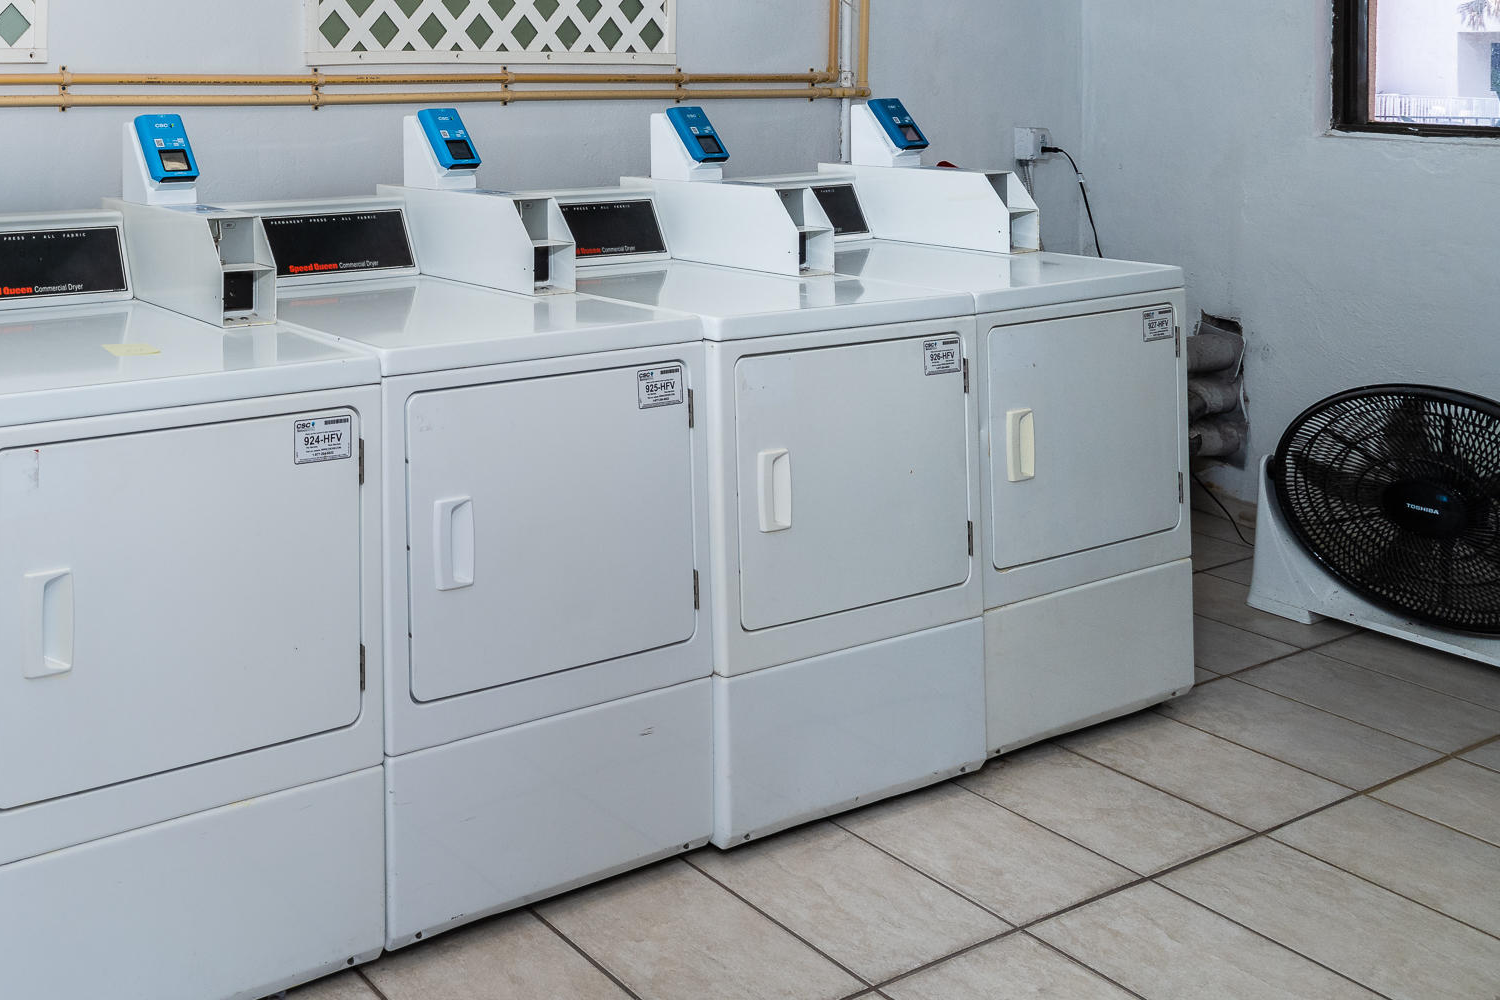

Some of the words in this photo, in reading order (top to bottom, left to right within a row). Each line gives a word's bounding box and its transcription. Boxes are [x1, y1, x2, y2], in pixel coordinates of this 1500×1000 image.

[289, 264, 314, 273] Speed
[313, 262, 339, 271] Queen
[339, 261, 366, 269] Commercial
[3, 286, 33, 295] Queen
[34, 284, 67, 293] Commercial
[68, 283, 83, 291] Dryer
[929, 351, 955, 361] 926-HFV
[645, 381, 675, 393] 925-HFV
[303, 432, 342, 446] 924-HFV
[1406, 502, 1439, 515] TOSHIBA
